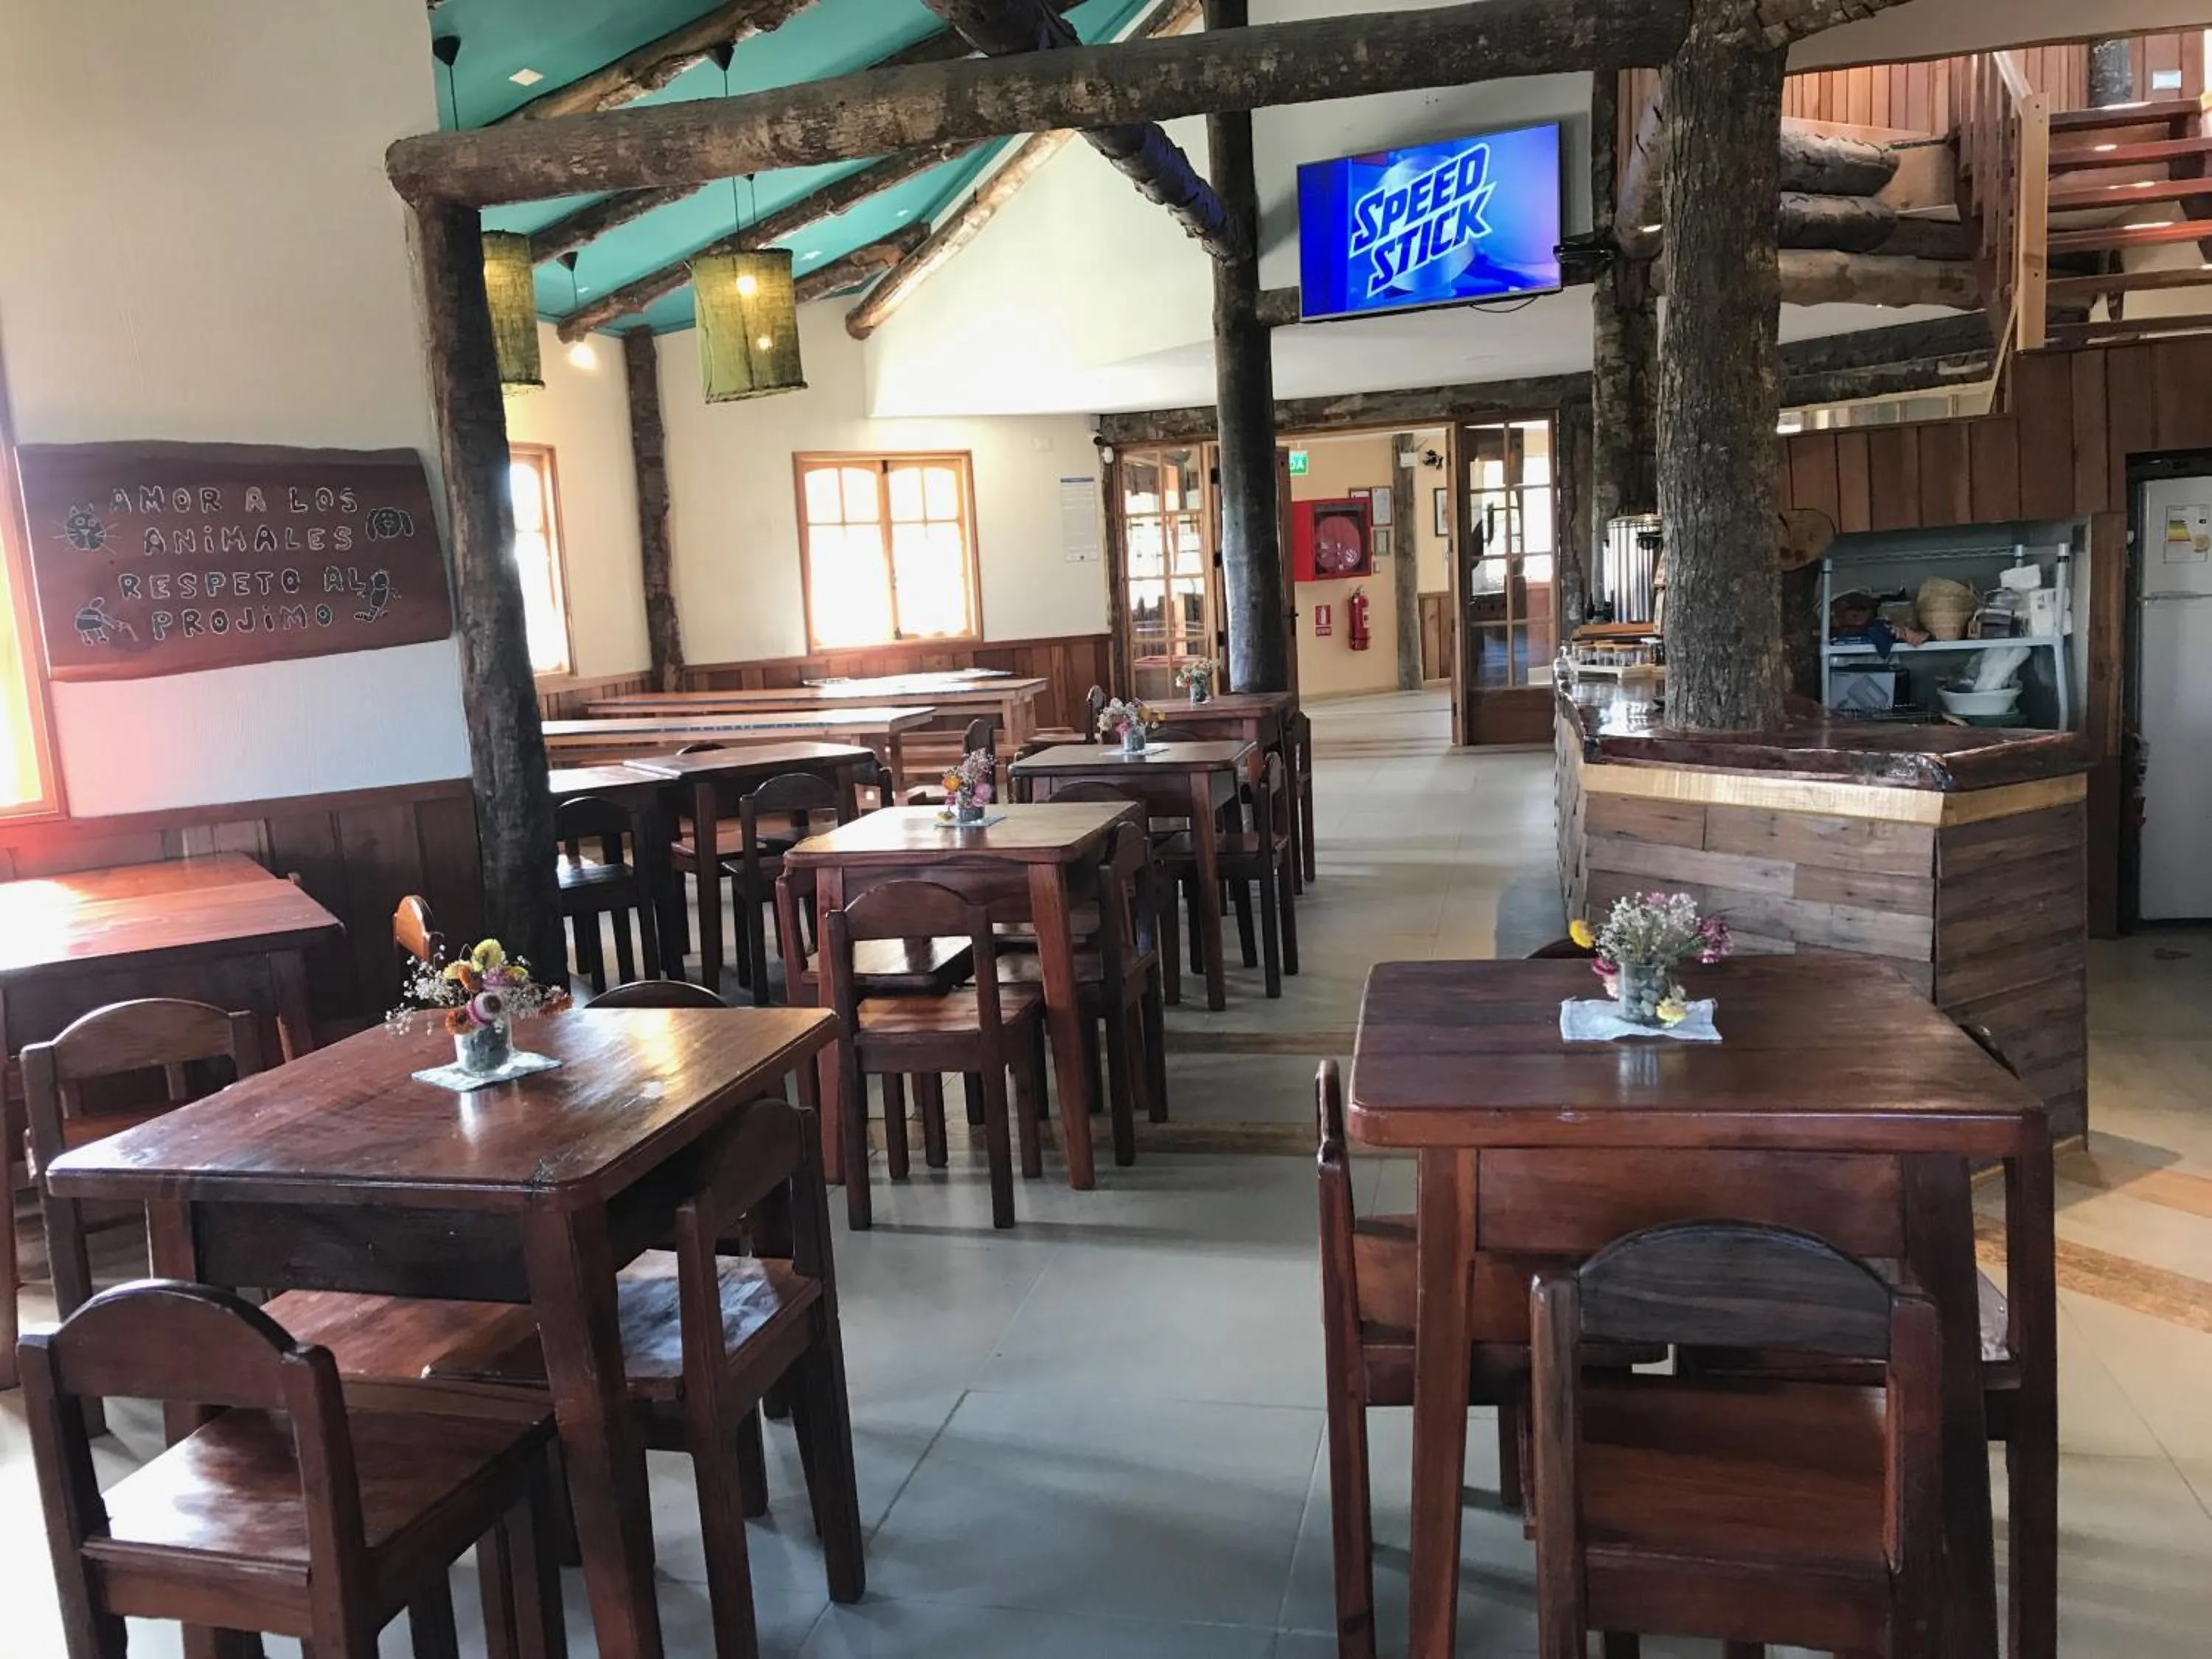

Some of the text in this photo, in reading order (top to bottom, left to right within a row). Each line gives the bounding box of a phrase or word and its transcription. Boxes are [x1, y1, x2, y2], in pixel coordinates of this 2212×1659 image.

[1350, 144, 1489, 256] SPEED
[1368, 184, 1495, 296] STICK
[111, 485, 358, 513] AMOR A LOS
[118, 566, 366, 599] RESPETO AL
